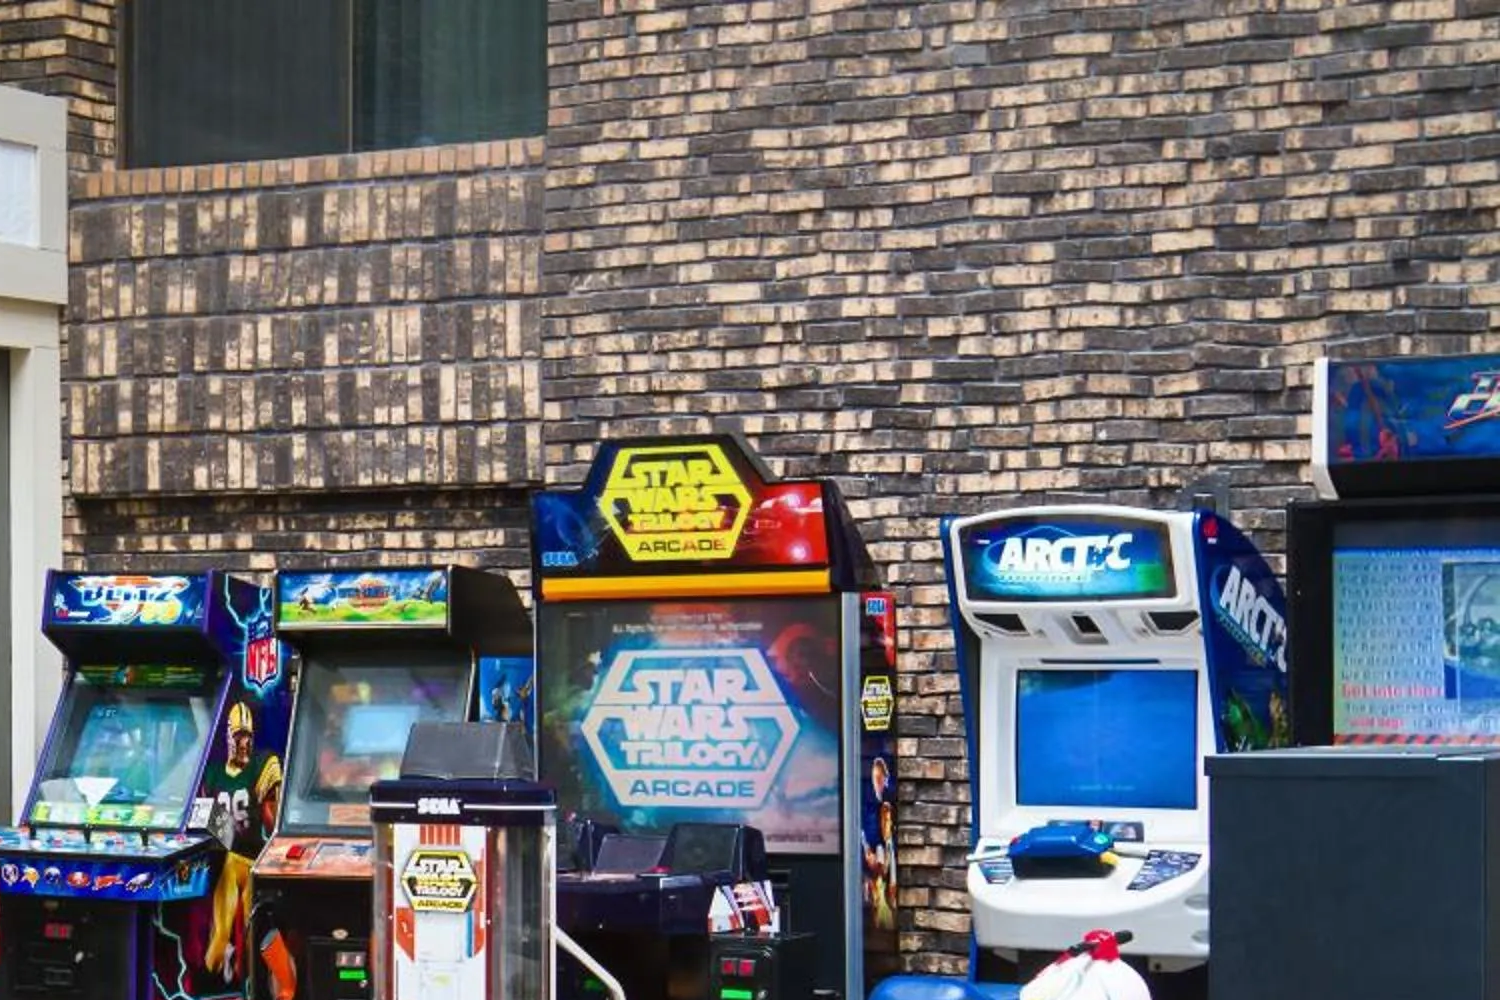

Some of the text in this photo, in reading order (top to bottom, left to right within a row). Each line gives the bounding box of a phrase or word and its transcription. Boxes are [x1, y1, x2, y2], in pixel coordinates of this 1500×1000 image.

[623, 459, 719, 487] STAR
[624, 483, 719, 514] WARS
[627, 510, 726, 532] TRILOGY
[637, 539, 726, 553] ARCADE
[998, 533, 1133, 572] ARCTIC
[246, 638, 277, 682] NFL
[631, 669, 750, 704] STAR
[622, 704, 752, 740] WARS
[620, 740, 760, 767] TRILOGY
[629, 779, 756, 798] ARCADE
[418, 798, 462, 815] SEGA
[417, 899, 463, 908] ARCADE
